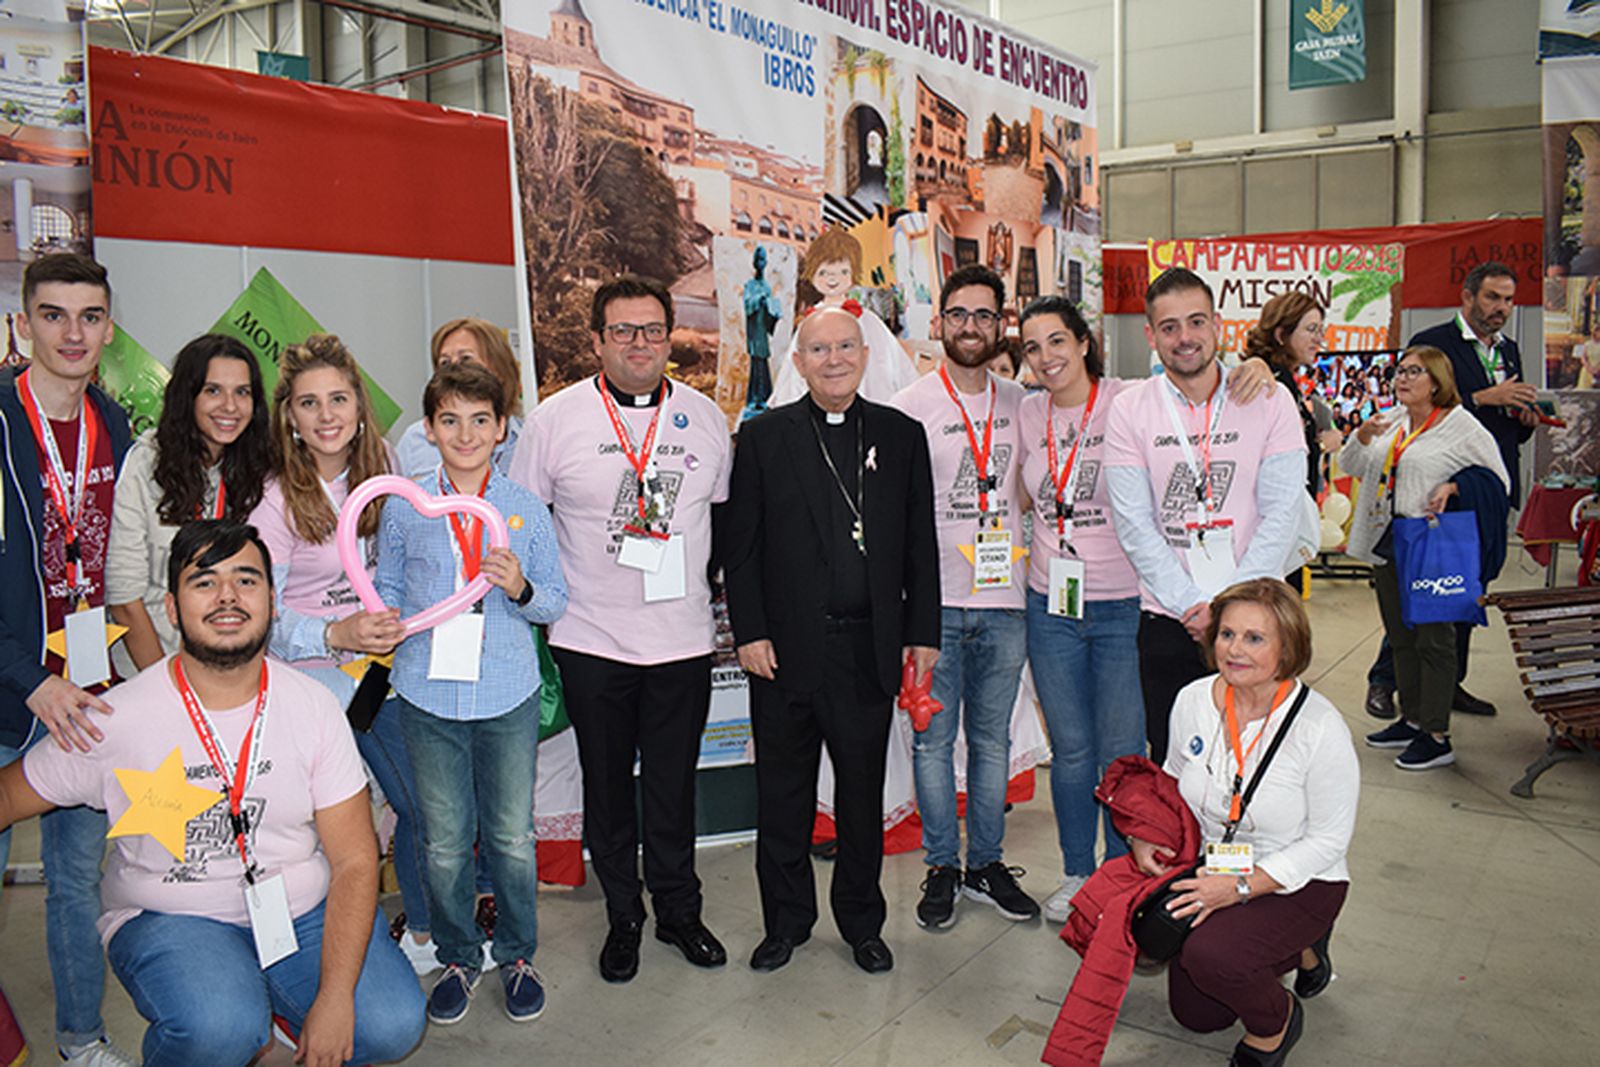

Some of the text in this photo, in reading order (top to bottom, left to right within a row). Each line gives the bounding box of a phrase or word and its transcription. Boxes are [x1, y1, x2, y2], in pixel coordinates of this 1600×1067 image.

[886, 0, 968, 66] ESPACIO
[972, 24, 995, 77] DE
[1000, 36, 1088, 110] ENCUENTRO
[764, 53, 815, 97] IBROS
[1152, 240, 1343, 272] CAMPAMENTO
[1218, 275, 1332, 309] MISIÓN
